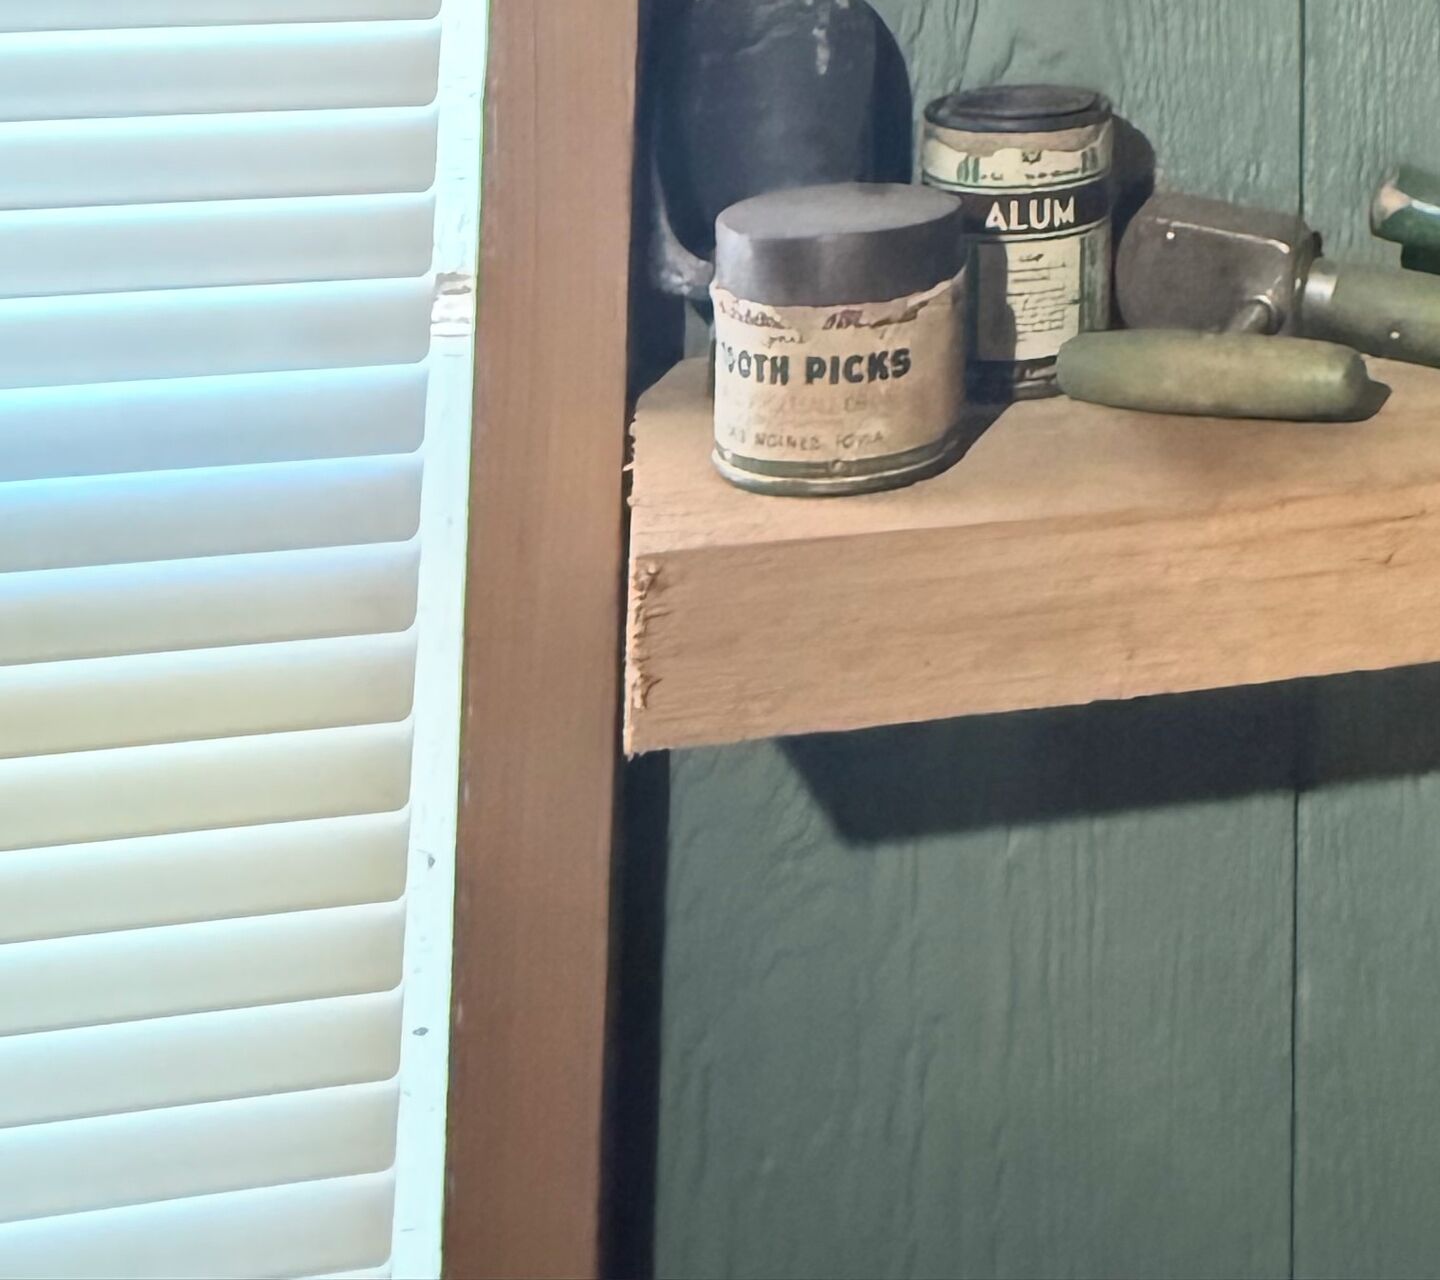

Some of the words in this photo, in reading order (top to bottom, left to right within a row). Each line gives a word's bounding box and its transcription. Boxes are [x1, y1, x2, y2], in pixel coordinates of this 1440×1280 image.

[985, 196, 1075, 231] ALUM
[721, 341, 790, 386] OOTH
[805, 347, 911, 385] PICKS
